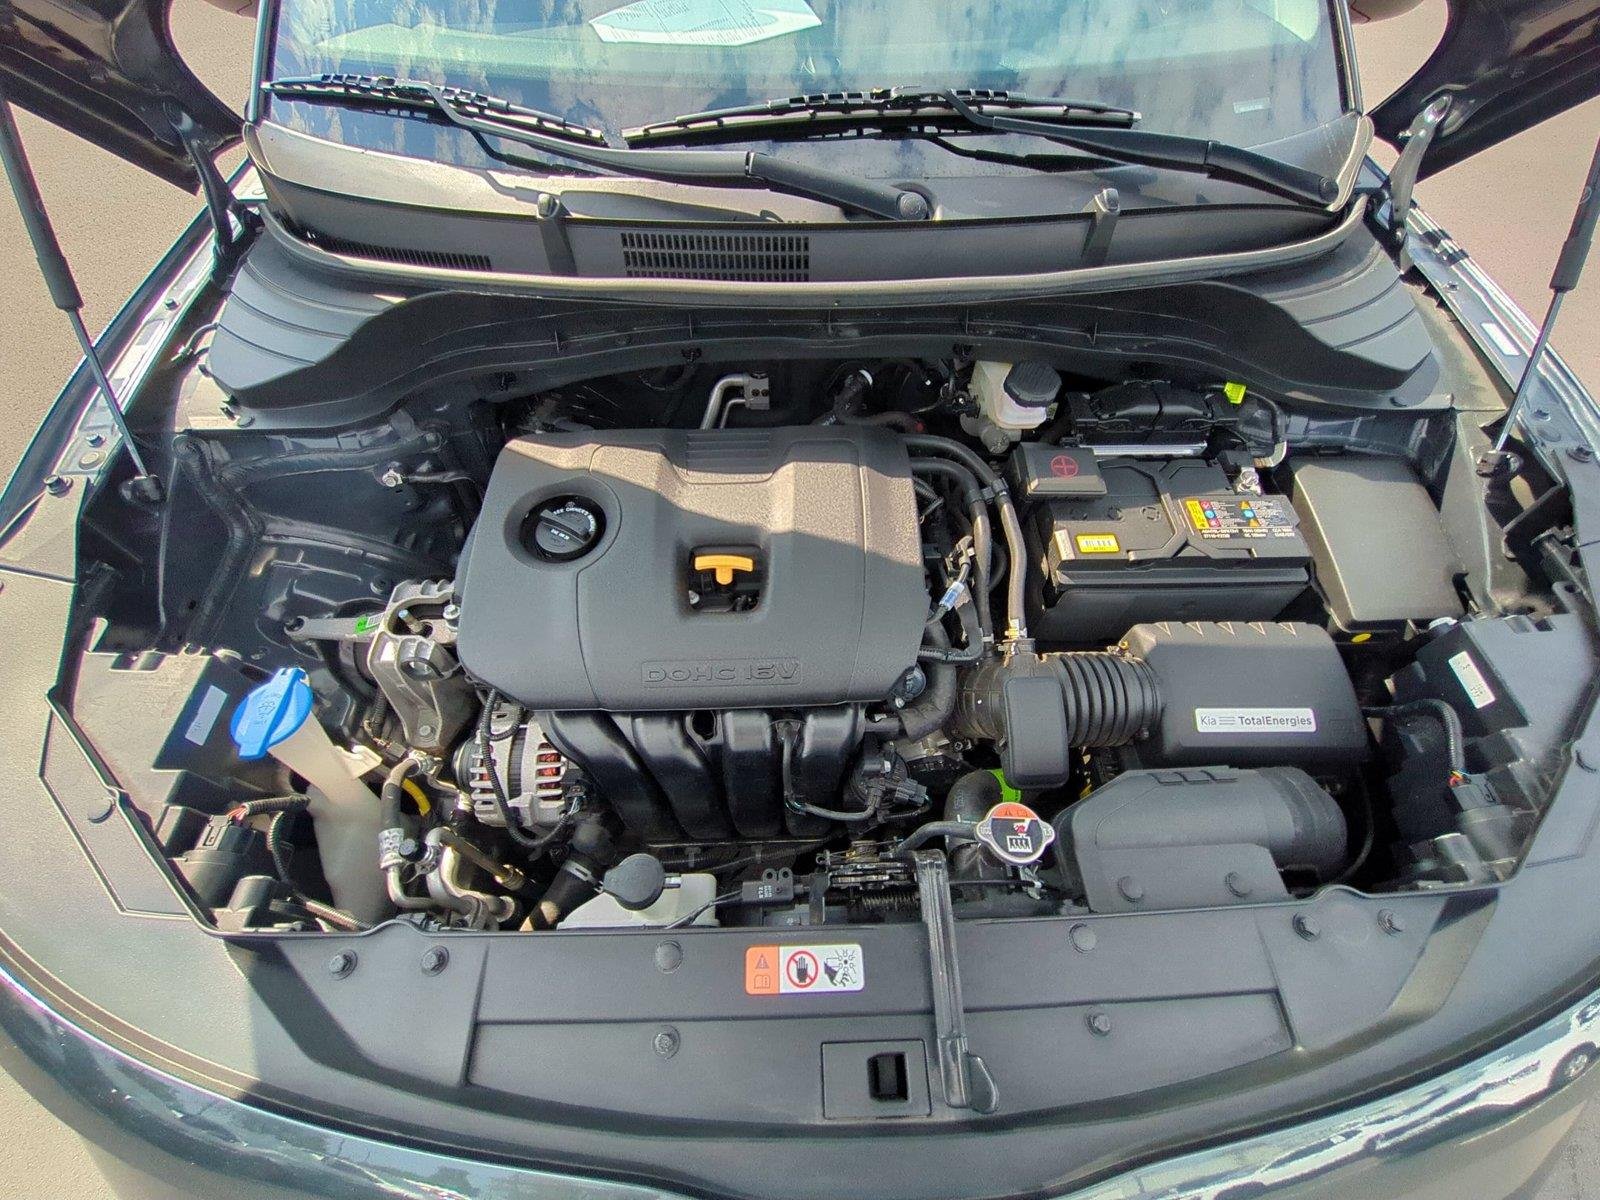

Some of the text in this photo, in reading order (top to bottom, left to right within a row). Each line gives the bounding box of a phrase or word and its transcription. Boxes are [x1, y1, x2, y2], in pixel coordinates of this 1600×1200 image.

[644, 662, 799, 682] DOHC 16V
[1200, 716, 1312, 727] Kia TotalEnergies
